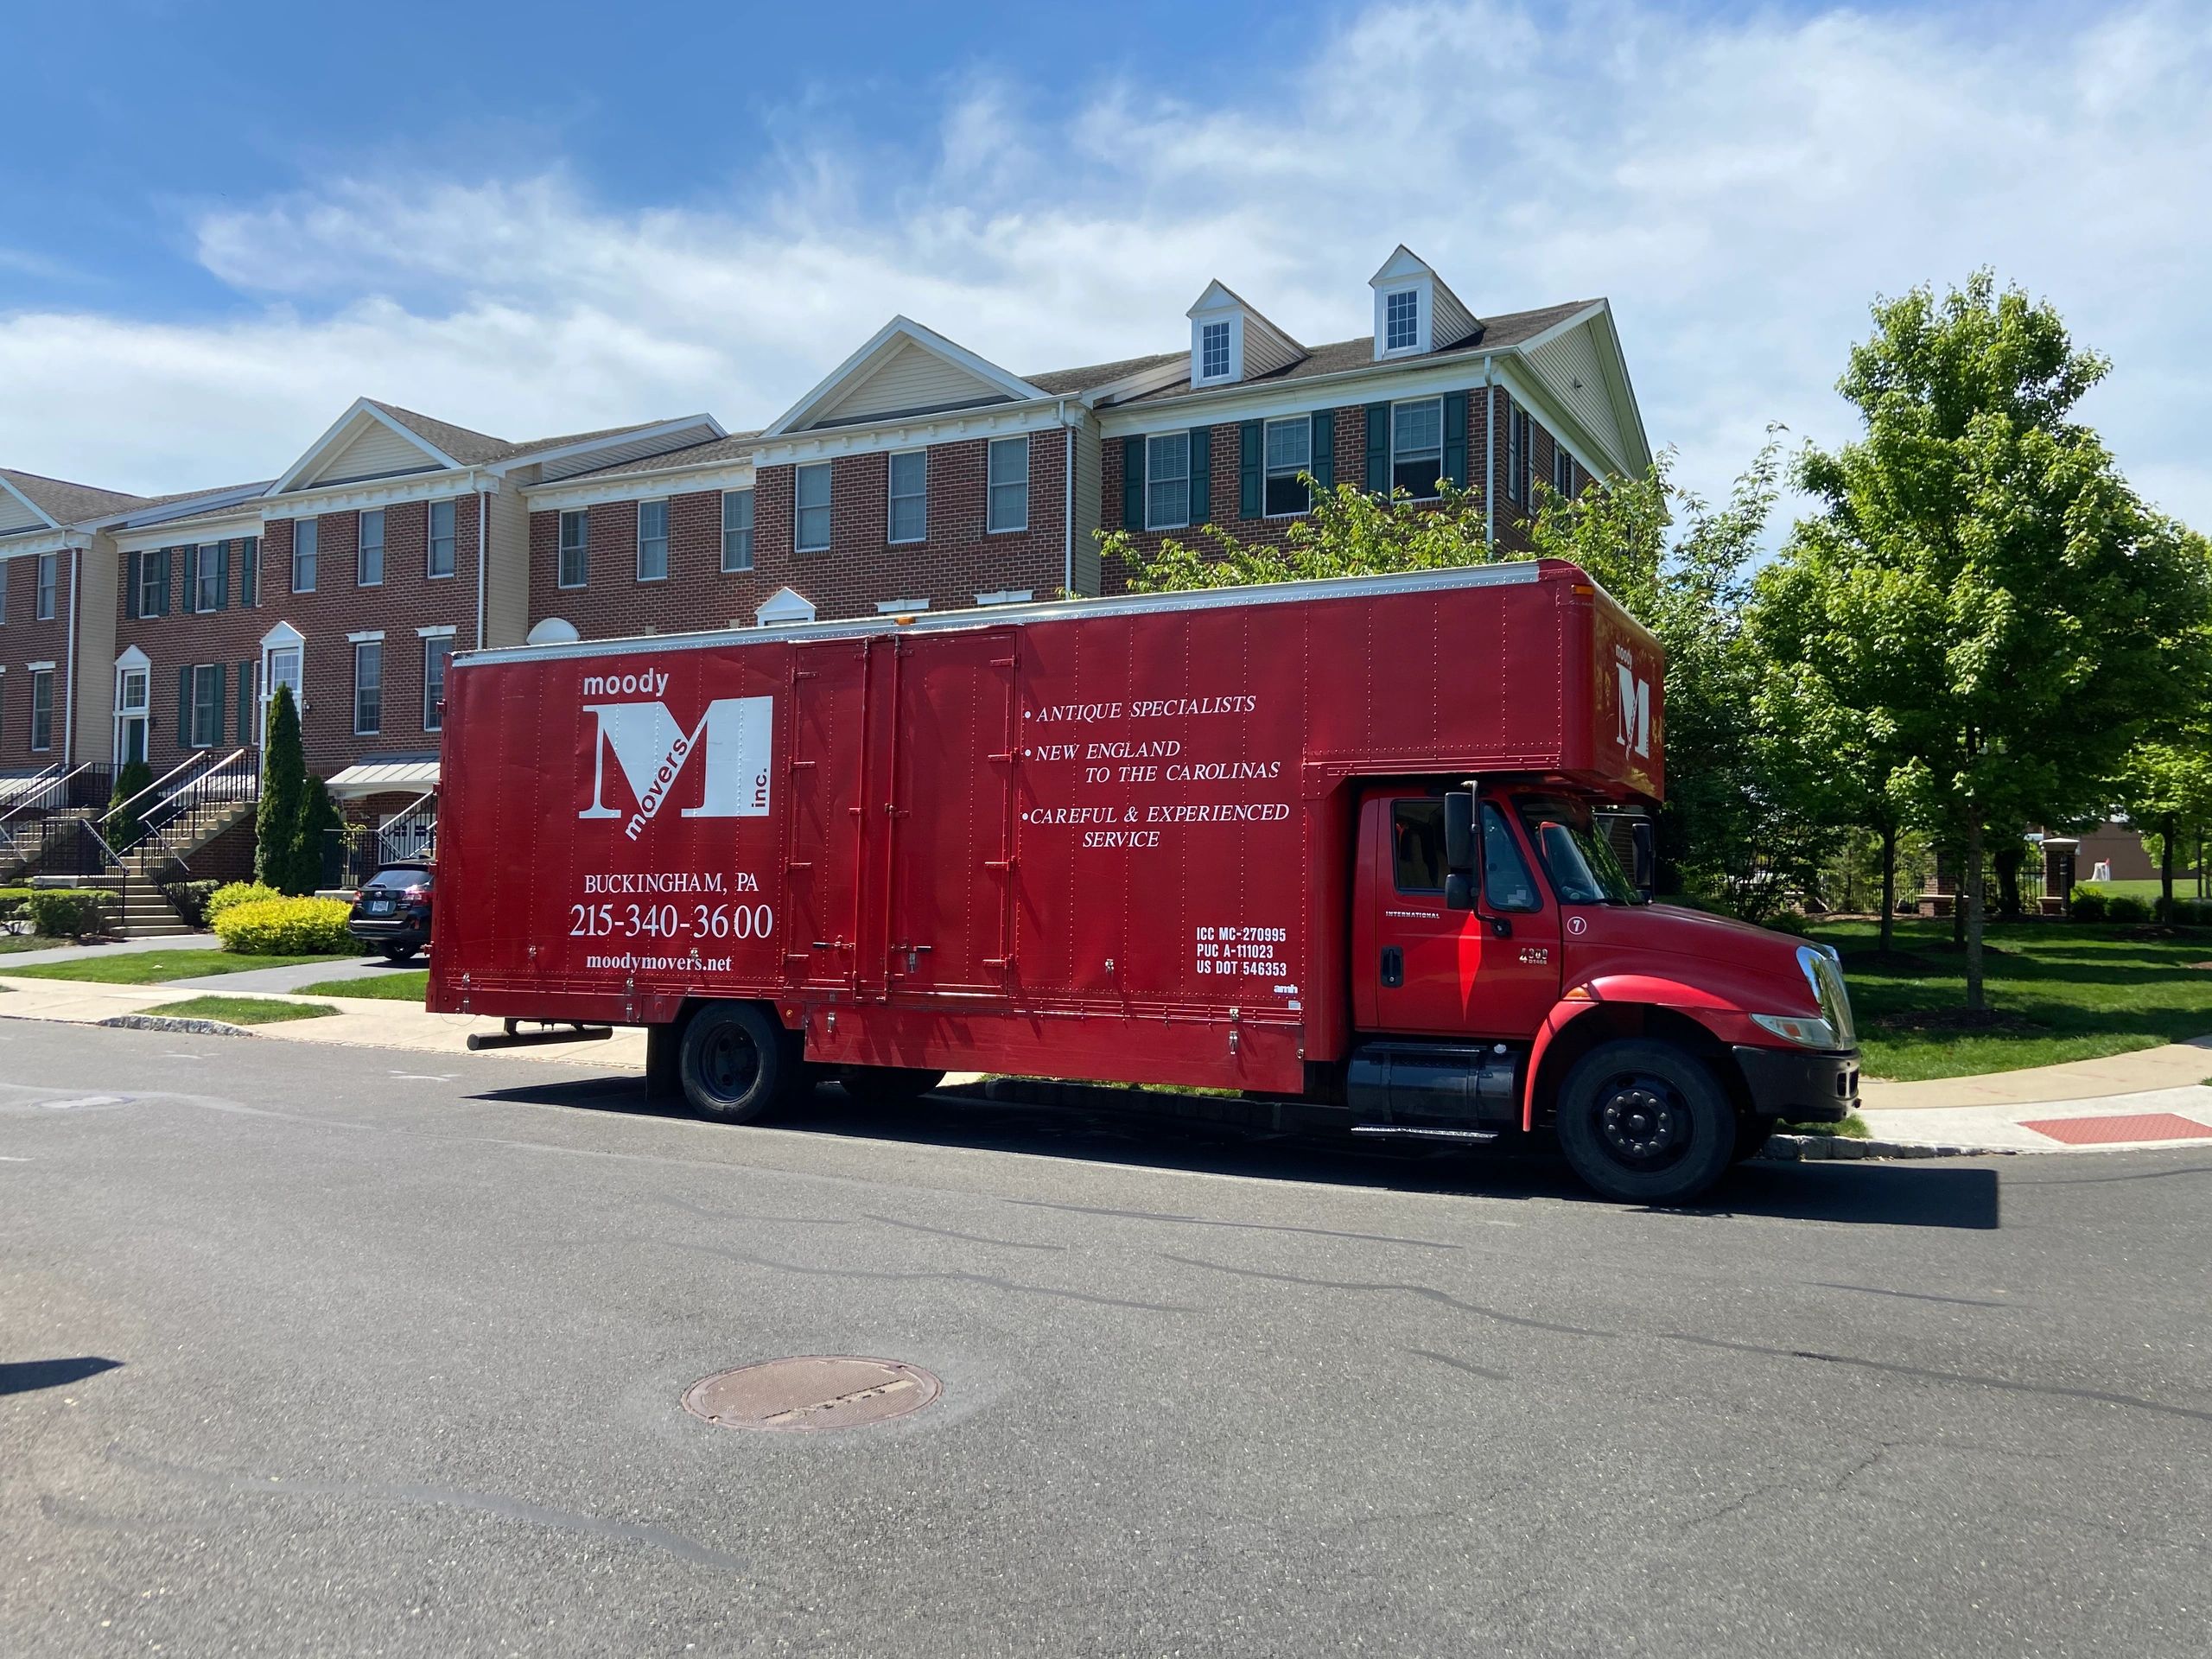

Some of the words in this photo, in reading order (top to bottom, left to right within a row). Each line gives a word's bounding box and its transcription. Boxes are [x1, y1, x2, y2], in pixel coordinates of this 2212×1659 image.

[583, 668, 669, 697] moody
[1036, 702, 1122, 723] ANTIQUE
[1130, 695, 1256, 717] SPECIALISTS
[1616, 662, 1649, 760] M
[578, 696, 773, 819] M
[1035, 744, 1079, 761] NEW
[1085, 741, 1180, 760] ENGLAND
[1085, 767, 1110, 783] TO
[1118, 766, 1158, 782] THE
[1166, 761, 1281, 781] CAROLINAS
[625, 737, 688, 841] movers
[751, 768, 767, 808] inc.
[1030, 807, 1117, 823] CAREFUL
[1123, 805, 1139, 822] &
[1146, 804, 1290, 823] EXPERIENCED
[1082, 831, 1160, 848] SERVICE
[584, 873, 728, 895] BUCKINGHAM,
[735, 872, 760, 892] PA
[569, 903, 774, 939] 215-340-3600
[1385, 911, 1440, 919] INTERNATIONAL
[1573, 919, 1580, 932] 7
[1196, 926, 1215, 941] ICC
[1218, 926, 1287, 943] MC-270995
[586, 951, 733, 972] moodymovers.net
[1196, 943, 1219, 957] PUC
[1223, 944, 1274, 959] A-111023
[1196, 959, 1211, 974] US
[1215, 960, 1238, 975] DOT
[1243, 961, 1287, 976] 546353
